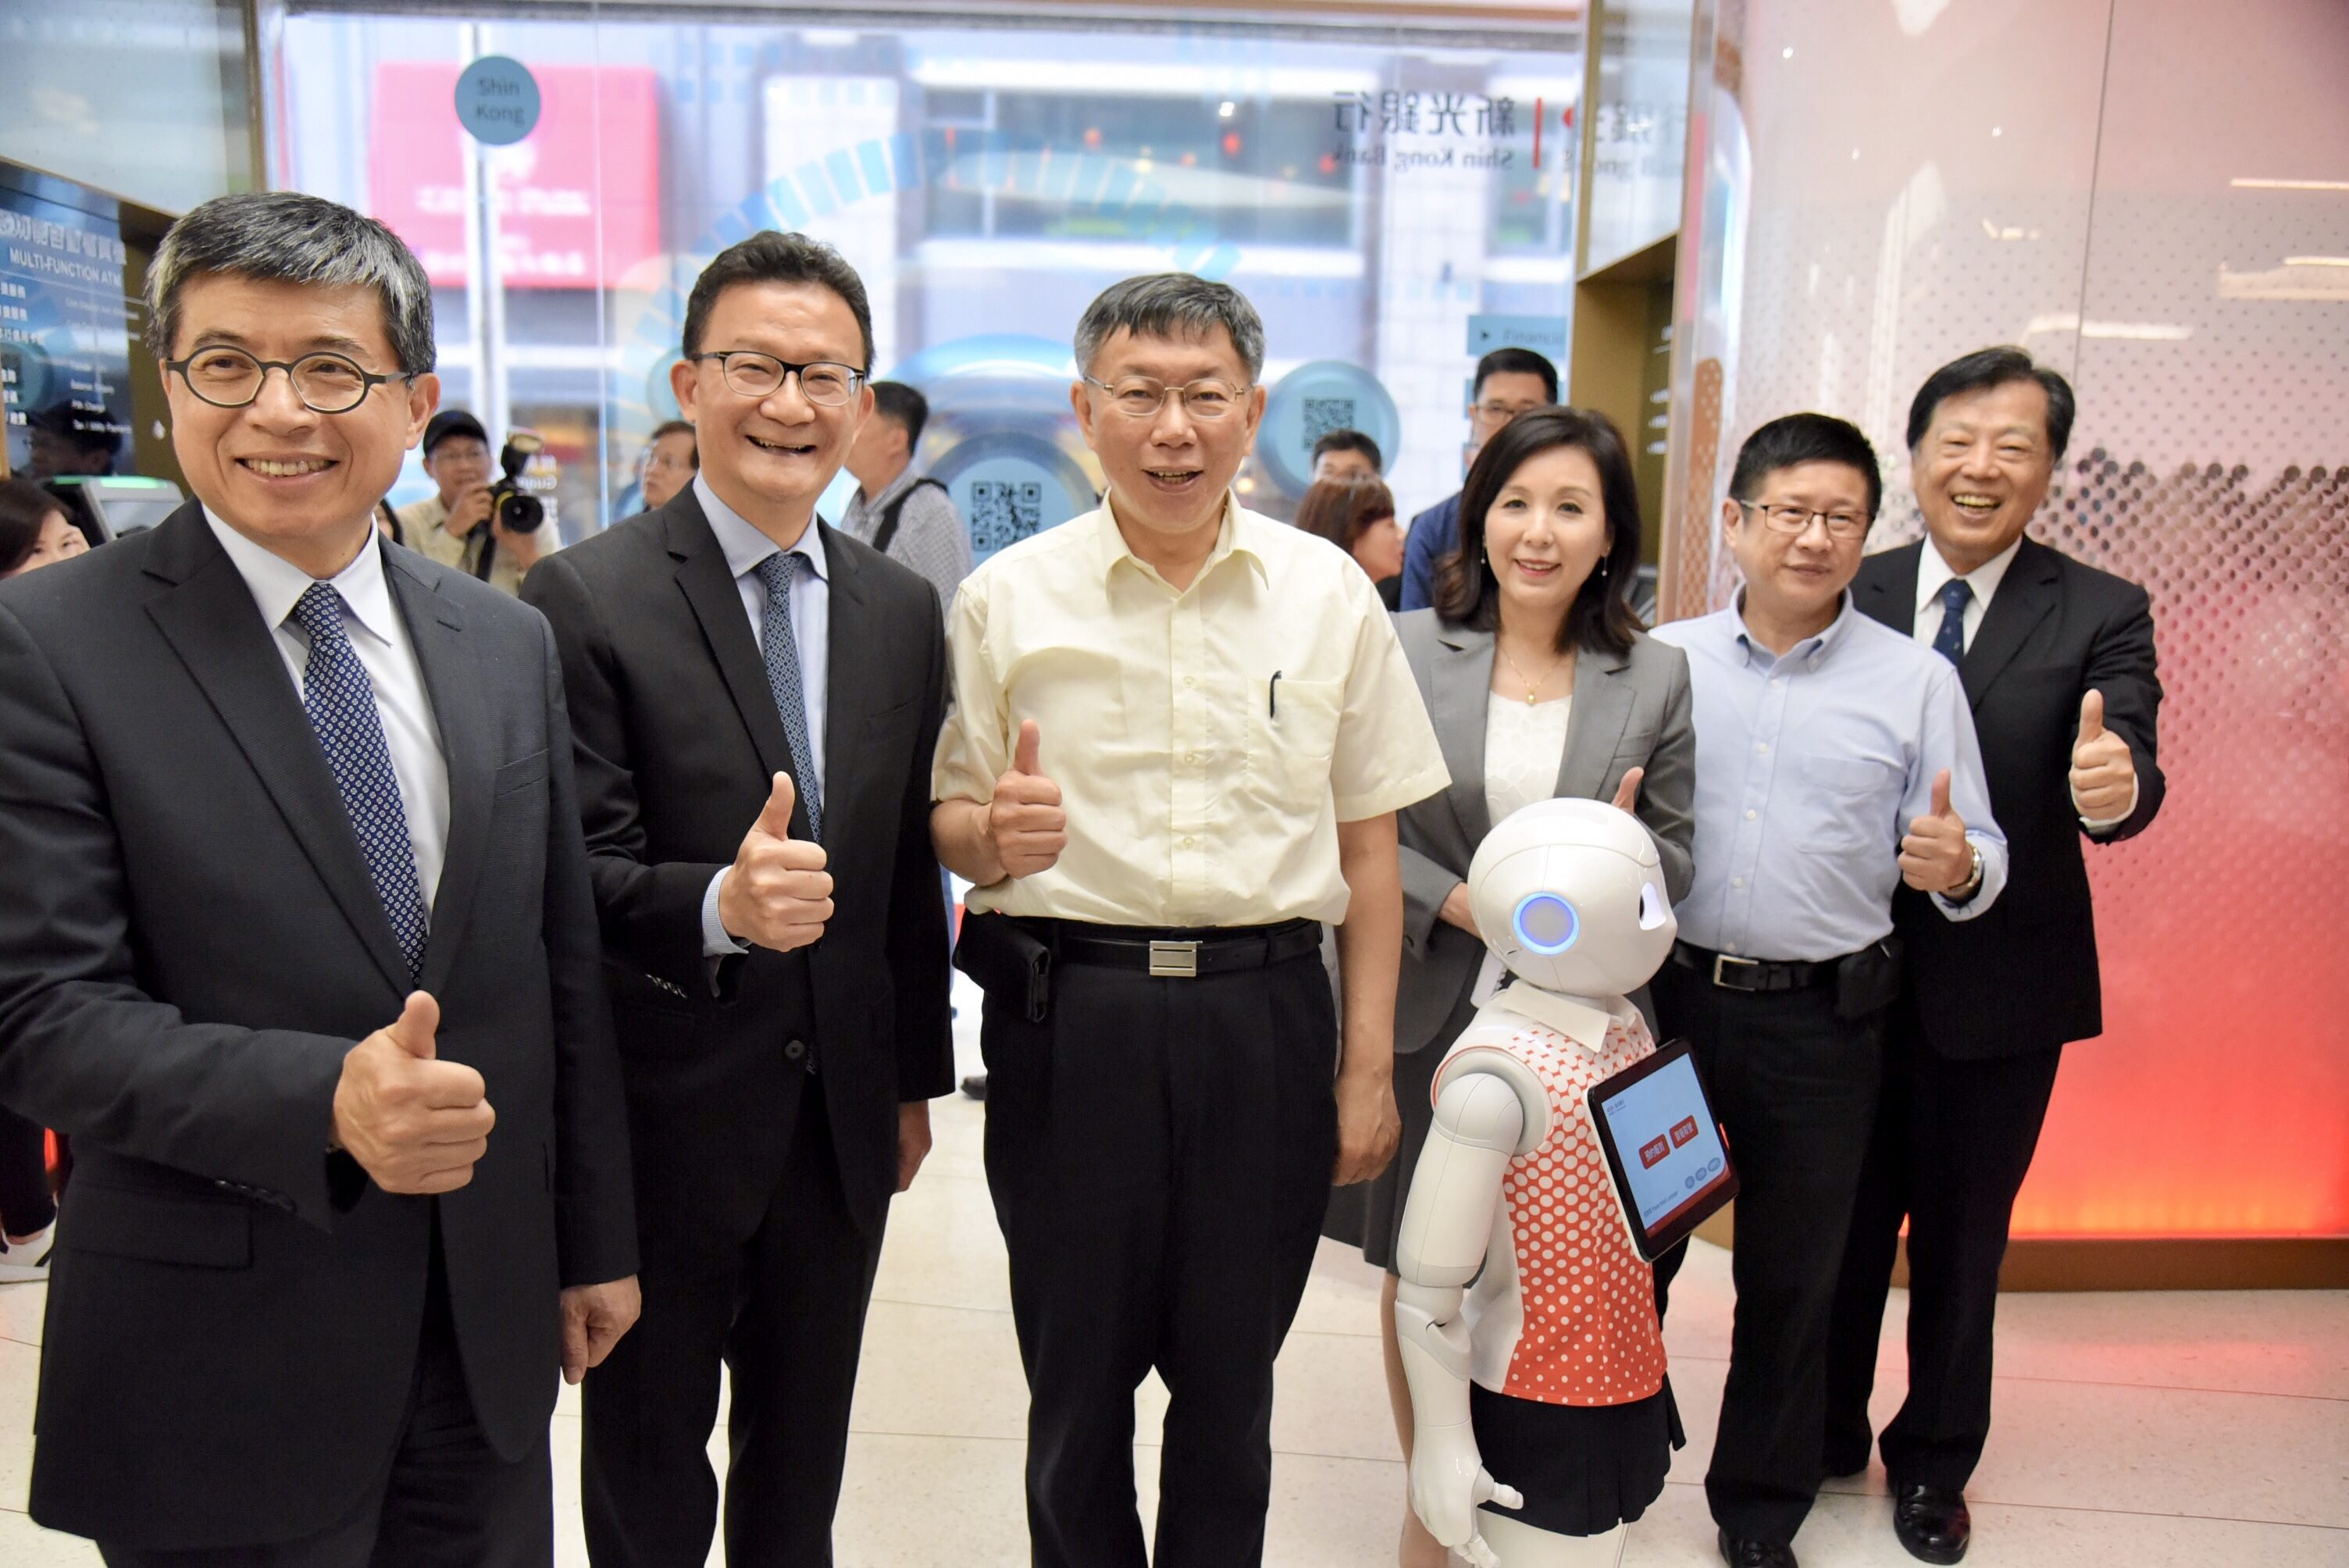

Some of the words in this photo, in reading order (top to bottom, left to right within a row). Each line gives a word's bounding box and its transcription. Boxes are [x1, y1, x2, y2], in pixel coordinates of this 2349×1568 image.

[478, 77, 520, 94] Shin
[476, 105, 525, 127] Kong
[9, 246, 99, 282] MULTI-FUNCTION
